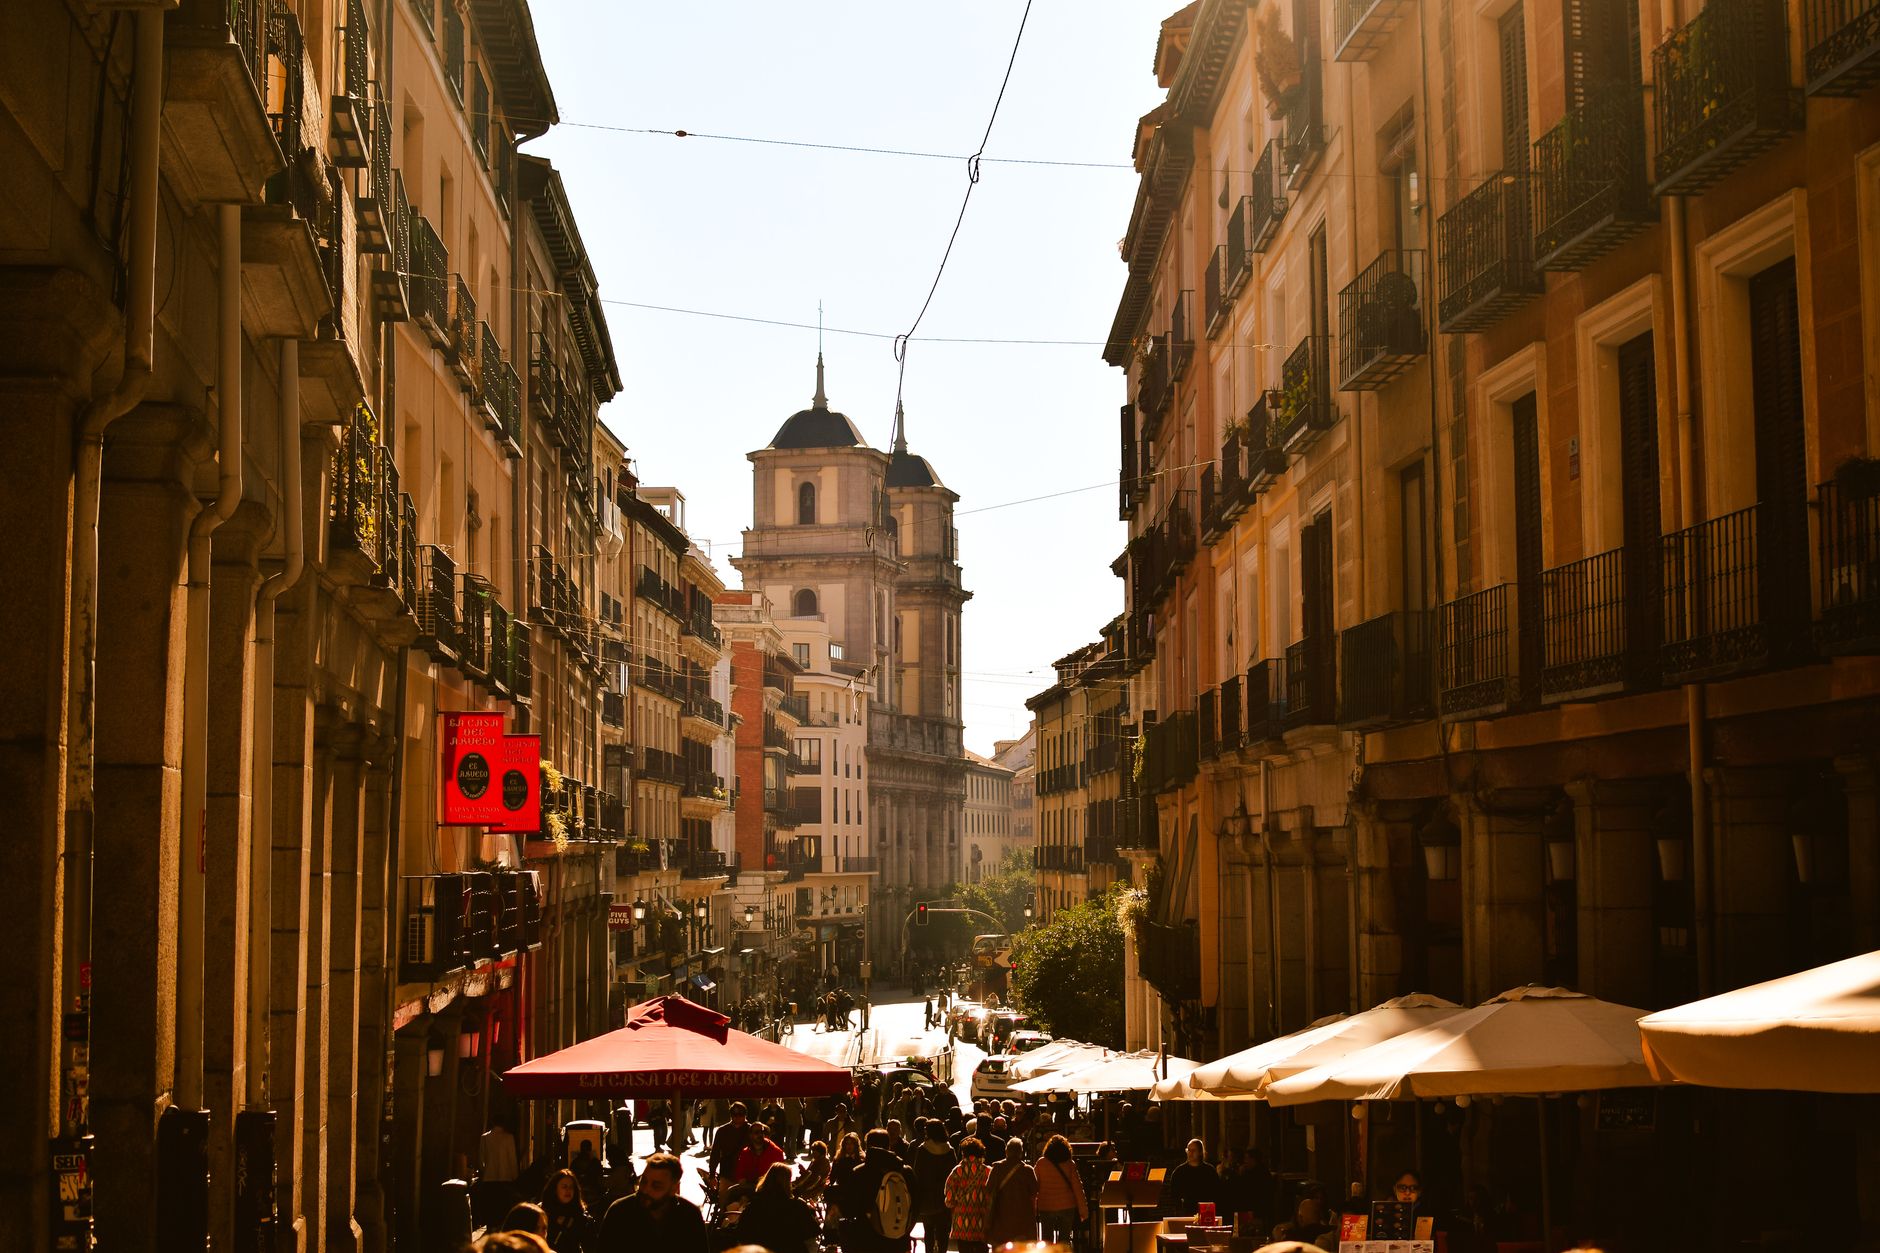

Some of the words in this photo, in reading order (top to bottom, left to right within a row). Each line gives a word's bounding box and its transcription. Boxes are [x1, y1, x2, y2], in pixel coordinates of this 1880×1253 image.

[449, 718, 464, 727] LA
[467, 718, 499, 727] CASA
[463, 727, 485, 736] DEL
[449, 736, 496, 745] ABUELO
[459, 770, 489, 778] ABUELO
[579, 1073, 604, 1088] LA
[608, 1072, 660, 1088] CASA
[664, 1071, 700, 1087] DEL
[703, 1072, 779, 1087] ABUELO
